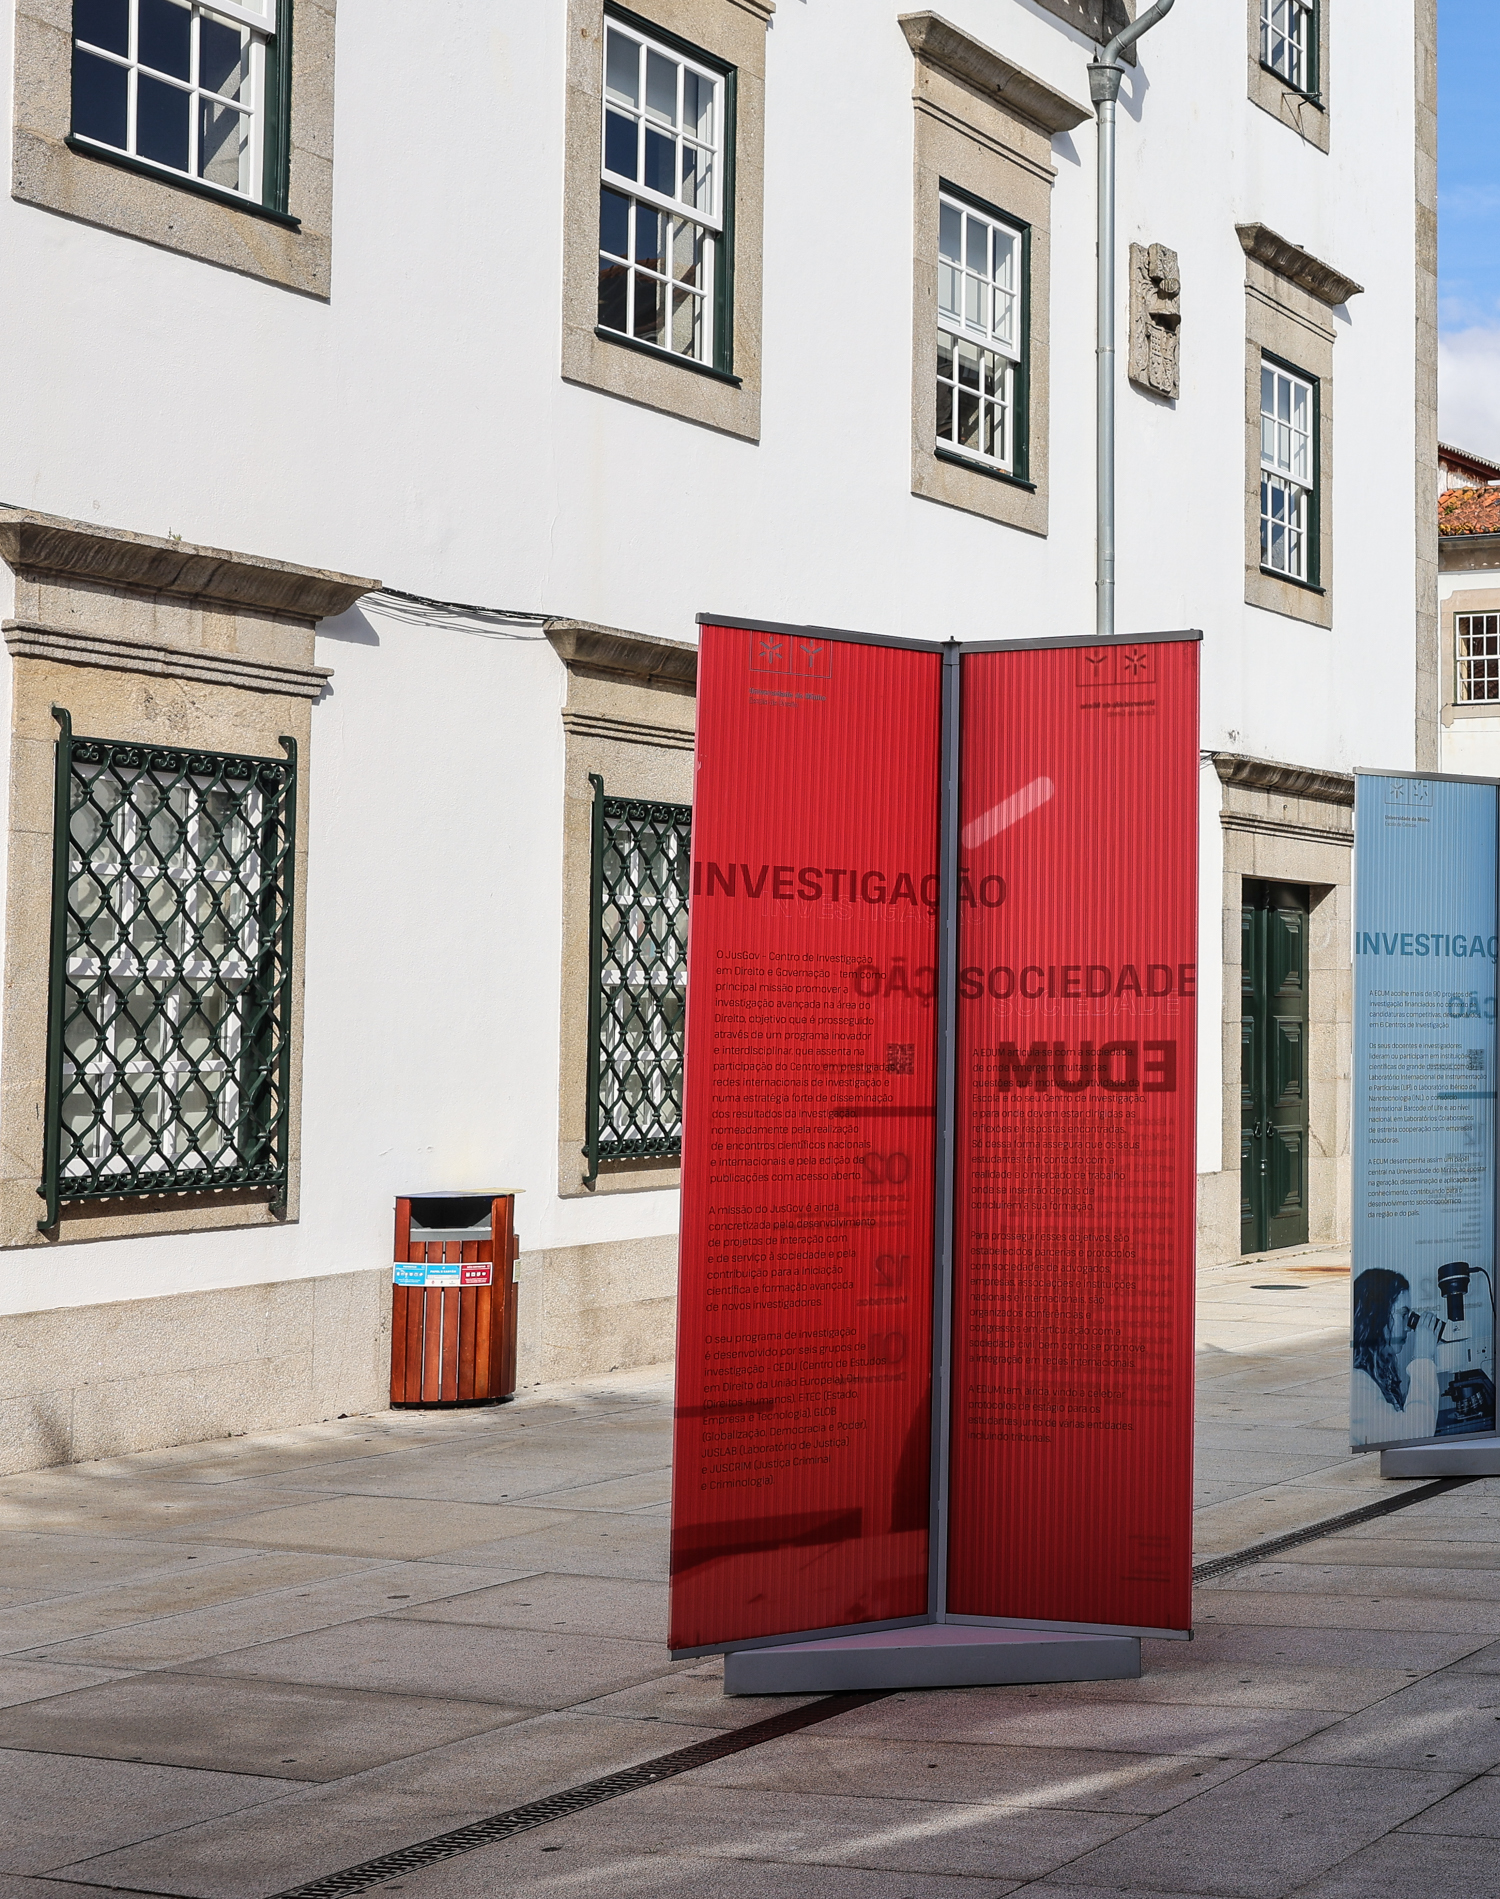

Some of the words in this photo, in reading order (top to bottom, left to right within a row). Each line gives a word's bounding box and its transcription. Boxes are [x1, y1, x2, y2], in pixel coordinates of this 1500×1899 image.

[693, 861, 1006, 915] INVESTIGAÇÃO
[716, 950, 724, 959] O
[725, 950, 760, 960] JusGov
[769, 952, 800, 961] Centro
[802, 953, 814, 962] de
[816, 953, 873, 964] Investigação
[960, 963, 1196, 999] SOCIEDADE
[716, 982, 757, 993] principal
[759, 983, 793, 993] missão
[796, 985, 841, 995] promover
[715, 1014, 747, 1025] Direito,
[749, 1015, 786, 1025] objetivo
[789, 1016, 807, 1026] que
[810, 1015, 815, 1025] é
[817, 1016, 874, 1027] prosseguido
[712, 1095, 740, 1103] numa
[743, 1093, 789, 1104] estratégia
[792, 1093, 813, 1102] forte
[816, 1093, 828, 1102] de
[830, 1093, 894, 1104] disseminação
[972, 1094, 1000, 1103] Escola
[1010, 1094, 1023, 1103] do
[1024, 1095, 1041, 1103] seu
[1042, 1093, 1073, 1103] Centro
[1074, 1094, 1087, 1103] de
[711, 1125, 789, 1135] nomeadamente
[791, 1125, 811, 1136] pela
[813, 1125, 859, 1135] realização
[972, 1124, 1012, 1134] reflexões
[1021, 1125, 1066, 1135] respostas
[971, 1155, 1021, 1164] estudantes
[1023, 1155, 1041, 1163] têm
[1043, 1156, 1084, 1164] contacto
[1085, 1156, 1106, 1164] com
[710, 1173, 769, 1184] publicações
[771, 1174, 793, 1182] com
[796, 1173, 829, 1181] acesso
[1017, 1278, 1074, 1289] associações
[1083, 1280, 1136, 1290] instituições
[704, 1364, 765, 1377] investigação
[773, 1362, 797, 1372] CEDU
[799, 1360, 833, 1372] (Centro
[835, 1359, 848, 1369] de
[850, 1356, 887, 1368] Estudos
[702, 1447, 737, 1459] JUSLAB
[739, 1441, 797, 1457] (Laboratório
[799, 1441, 811, 1450] de
[812, 1436, 850, 1449] Justiça)
[701, 1465, 708, 1475] e
[709, 1461, 752, 1474] JUSCRIM
[753, 1458, 791, 1471] (Justiça
[793, 1454, 831, 1467] Criminal
